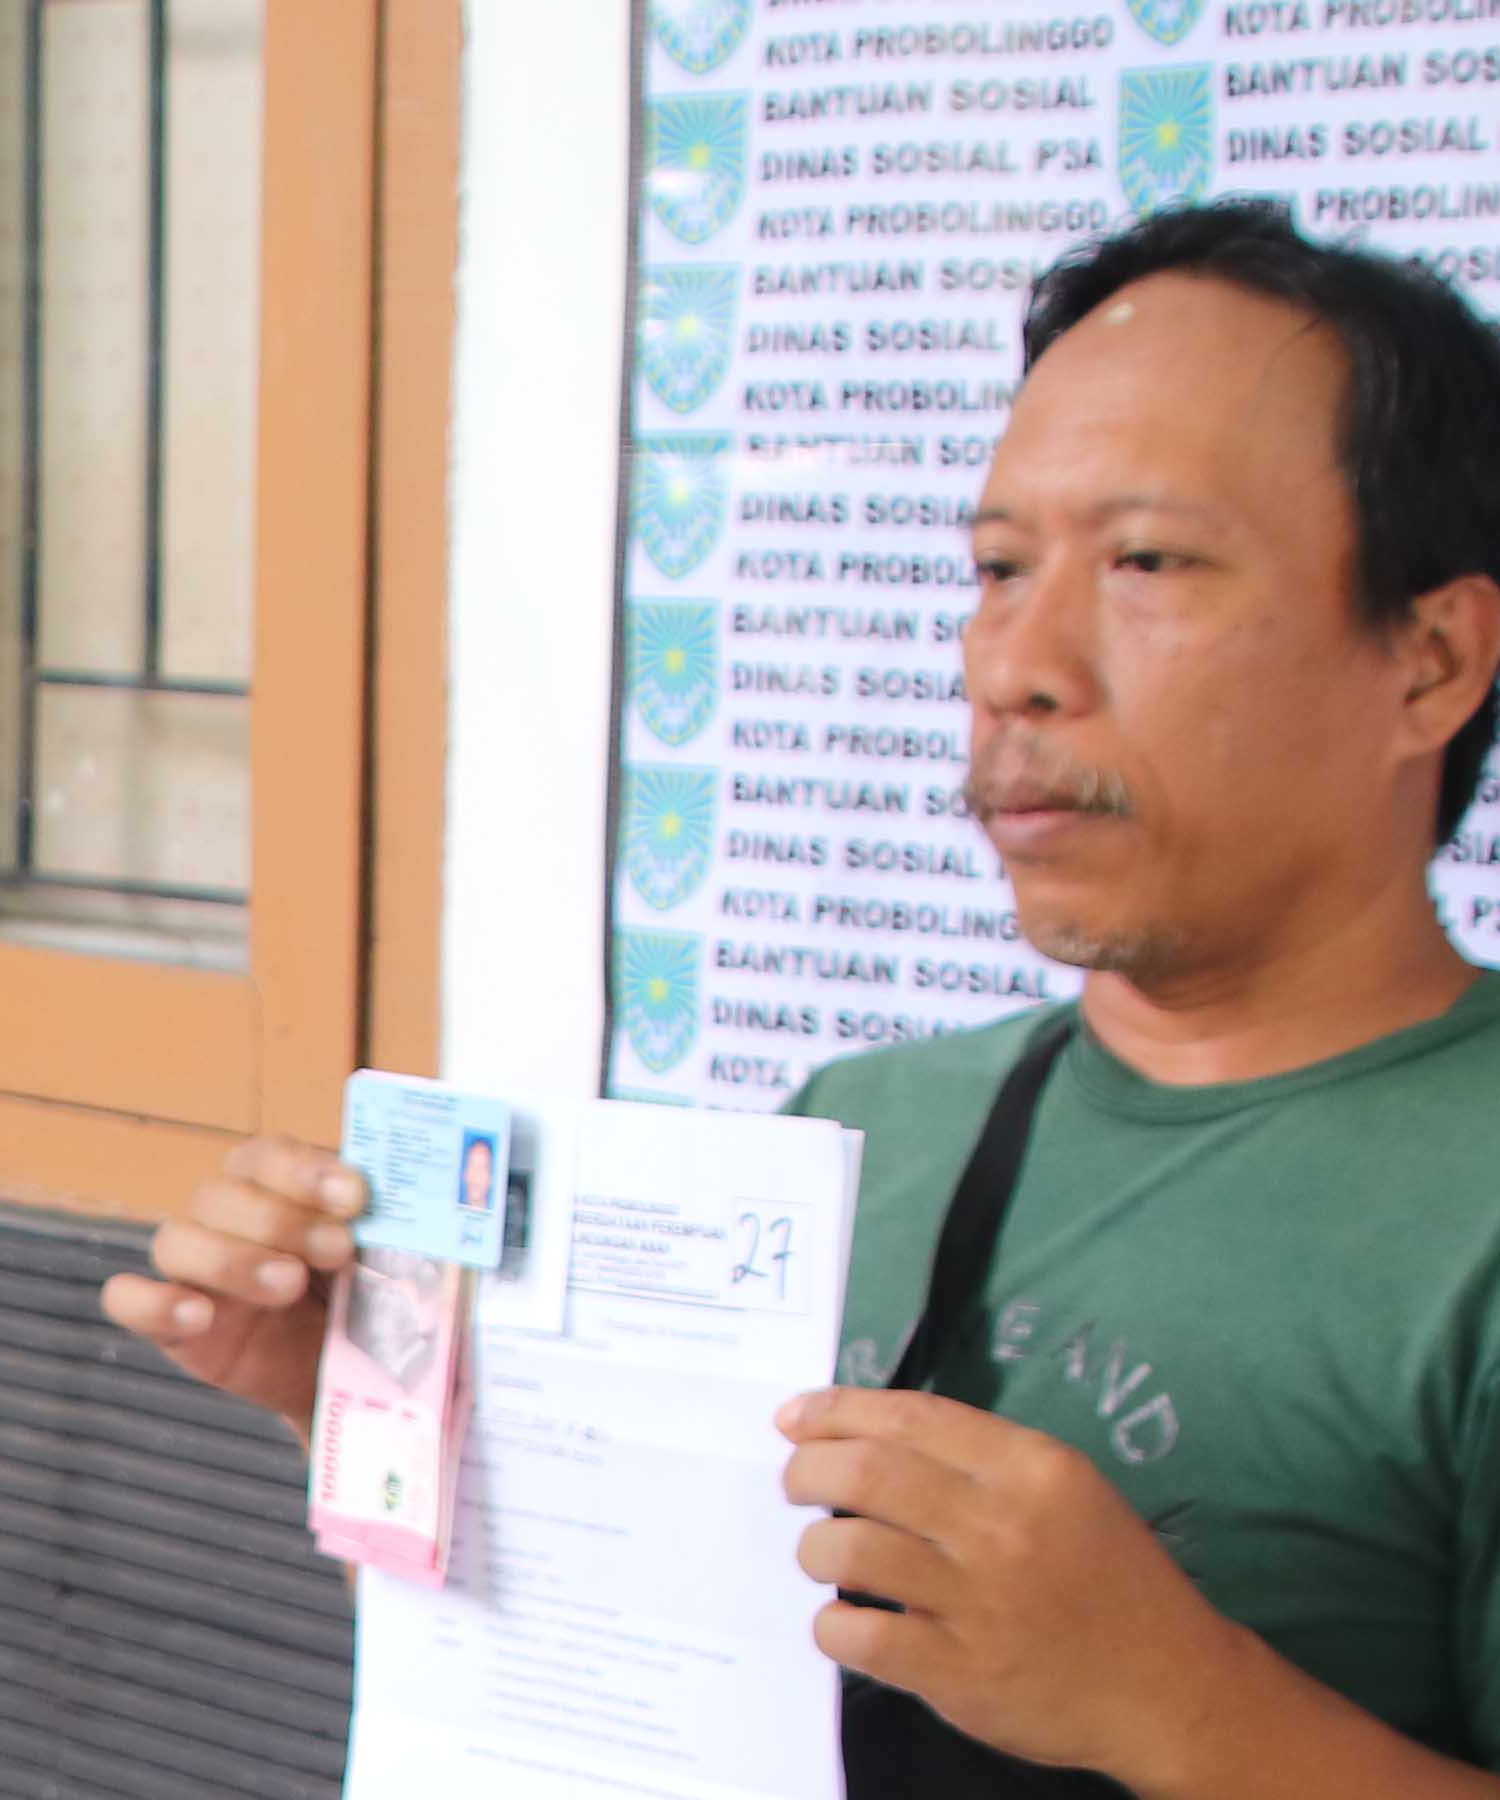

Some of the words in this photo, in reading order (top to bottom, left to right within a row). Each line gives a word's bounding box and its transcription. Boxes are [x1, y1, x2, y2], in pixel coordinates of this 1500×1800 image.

[763, 32, 842, 68] KOTA
[853, 15, 1113, 63] PROBOLINGGO
[1224, 55, 1404, 98] BANTUAN
[762, 83, 931, 122] BANTUAN
[948, 75, 1094, 116] SOSIAL
[1226, 125, 1326, 163] DINAS
[1342, 116, 1487, 159] SOSIAL
[760, 148, 857, 182] DINAS
[870, 139, 1014, 178] SOSIAL
[1034, 139, 1102, 172] P3A
[756, 207, 834, 240] KOTA
[845, 197, 1108, 240] PROBOLINGGO
[753, 262, 923, 296] BANTUAN
[747, 323, 851, 354] DINAS
[864, 320, 1002, 353] SOSIAL
[742, 381, 828, 411] KOTA
[740, 493, 848, 525] DINAS
[735, 550, 824, 581] KOTA
[731, 605, 918, 642] BANTUAN
[731, 663, 839, 696] DINAS
[730, 720, 810, 752] KOTA
[732, 775, 908, 814] BANTUAN
[728, 831, 827, 867] DINAS
[843, 839, 979, 880] SOSIAL
[720, 888, 800, 923] KOTA
[715, 941, 897, 987] BANTUAN
[914, 960, 1051, 1001] SOSIAL
[712, 1000, 819, 1036] DINAS
[709, 1053, 793, 1090] KOTA
